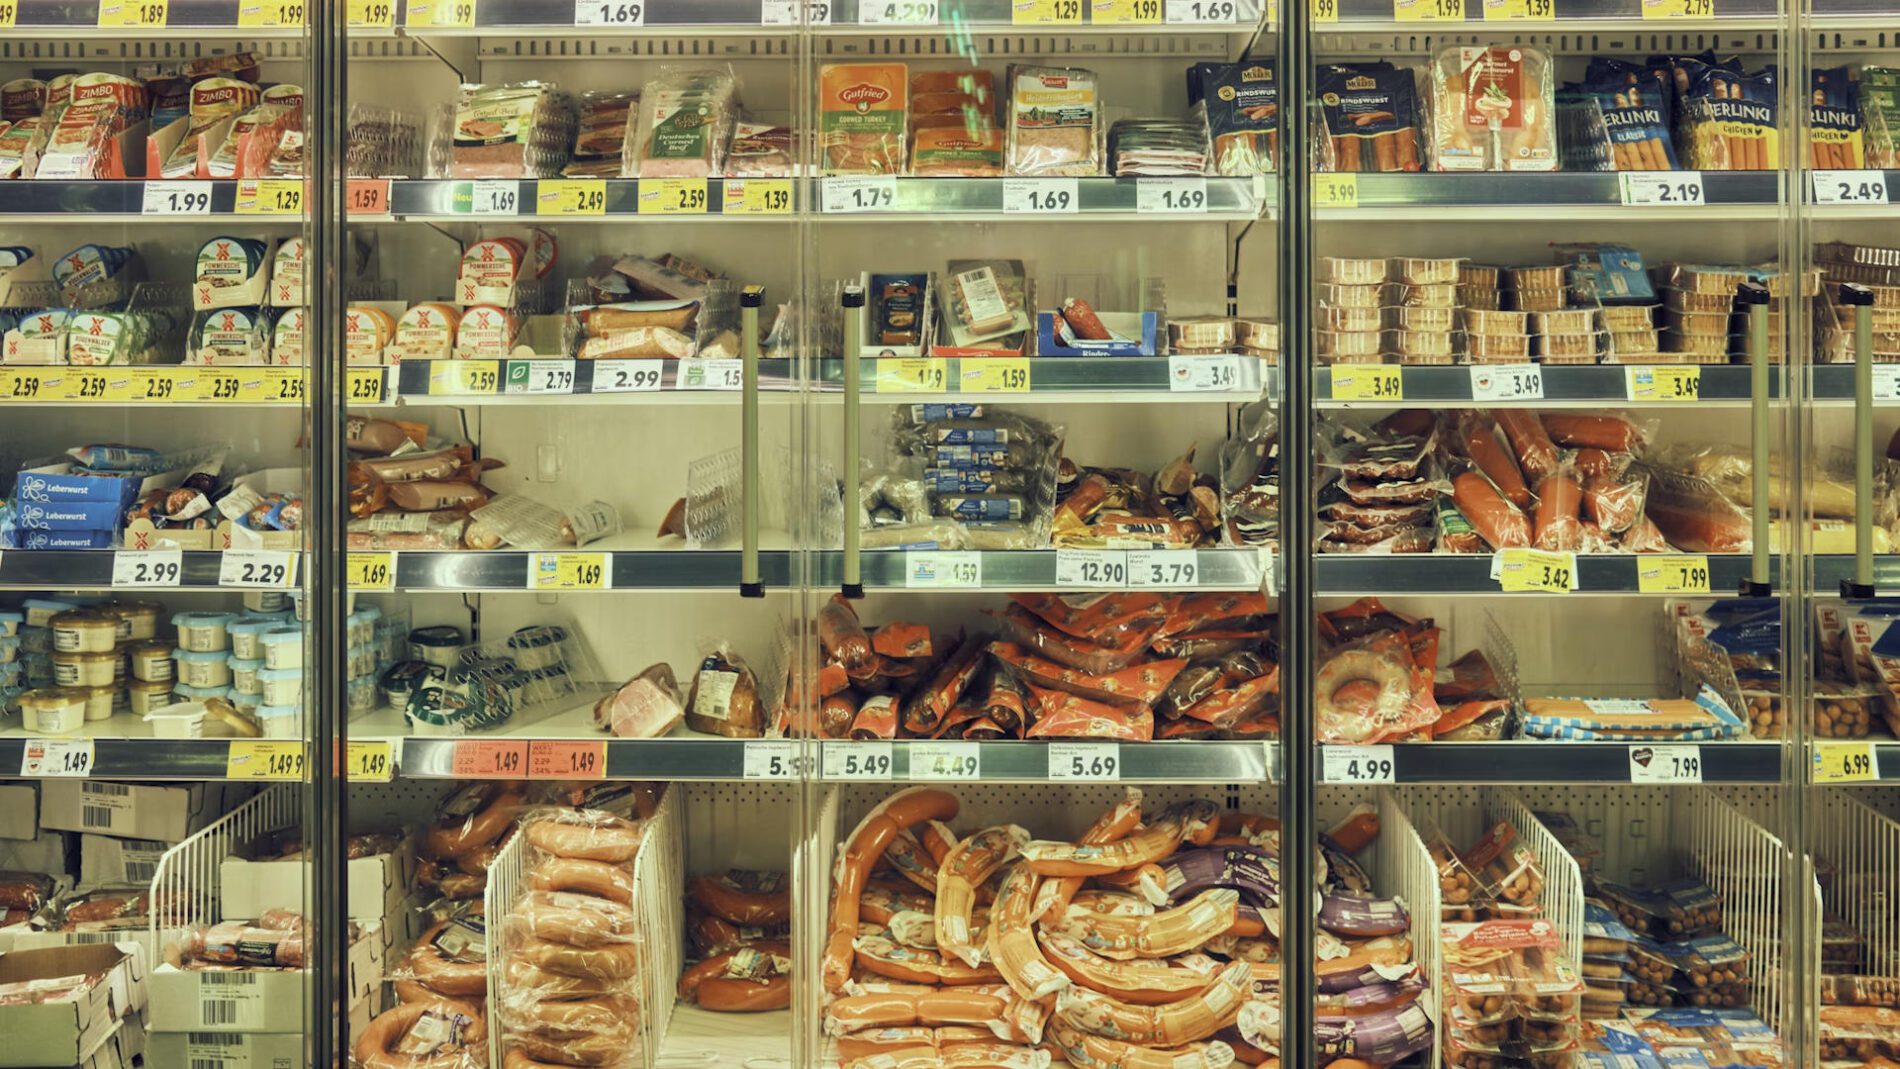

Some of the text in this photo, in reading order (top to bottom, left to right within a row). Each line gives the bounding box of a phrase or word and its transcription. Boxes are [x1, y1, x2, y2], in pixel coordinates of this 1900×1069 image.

[141, 5, 163, 23] 1.89
[280, 5, 302, 24] 1.99
[365, 4, 388, 23] 1.99
[600, 4, 641, 22] 1.69
[1054, 1, 1078, 19] 1.29
[1133, 1, 1157, 18] 1.99
[1191, 2, 1233, 20] 1.69
[1436, 0, 1460, 16] 1.99
[1526, 0, 1550, 15] 1.39
[80, 86, 114, 99] ZIMBO
[200, 90, 233, 103] ZIMBO
[843, 87, 884, 101] Gutfried
[1341, 97, 1388, 105] RINDSWURST
[864, 115, 887, 124] TURKEY
[1604, 110, 1660, 127] ERLINKI
[659, 134, 700, 143] Deutsches
[663, 141, 695, 149] Corned
[276, 191, 299, 210] 1.29
[355, 190, 378, 208] 1.59
[680, 189, 704, 208] 2.59
[765, 191, 788, 209] 1.39
[853, 188, 893, 207] 1.79
[1029, 191, 1070, 210] 1.69
[1163, 190, 1204, 208] 1.69
[1329, 184, 1355, 202] 3.99
[1658, 184, 1699, 203] 2.19
[1838, 182, 1884, 200] 2.49
[168, 193, 208, 212] 1.99
[491, 192, 515, 211] 1.69
[578, 191, 603, 211] 2.49
[13, 377, 39, 398] 2.59
[80, 377, 106, 397] 2.59
[146, 378, 172, 398] 2.59
[213, 378, 239, 398] 2.59
[353, 378, 378, 398] 2.59
[469, 371, 495, 391] 2.59
[546, 368, 572, 389] 2.79
[615, 370, 659, 387] 2.99
[1002, 369, 1026, 388] 1.59
[1373, 377, 1400, 396] 3.49
[1513, 375, 1539, 394] 3.49
[47, 484, 88, 495] Leberwurst
[46, 512, 87, 521] Leberwurst
[50, 538, 91, 547] Leberwurst
[135, 563, 178, 582] 2.99
[242, 563, 285, 583] 2.29
[363, 564, 386, 583] 1.69
[577, 564, 601, 584] 1.69
[1081, 562, 1123, 582] 12.90
[1151, 564, 1195, 583] 3.79
[1542, 566, 1571, 589] 3.42
[1680, 568, 1706, 588] 7.99
[65, 752, 88, 771] 1.49
[269, 754, 293, 774] 1.49
[362, 754, 385, 774] 1.49
[495, 752, 518, 771] 1.49
[571, 752, 594, 771] 1.49
[846, 755, 889, 774] 5.49
[932, 756, 976, 776] 4.49
[1072, 756, 1115, 776] 5.69
[1347, 759, 1391, 779] 4.99
[1672, 757, 1698, 777] 7.99
[1844, 754, 1869, 775] 6.99
